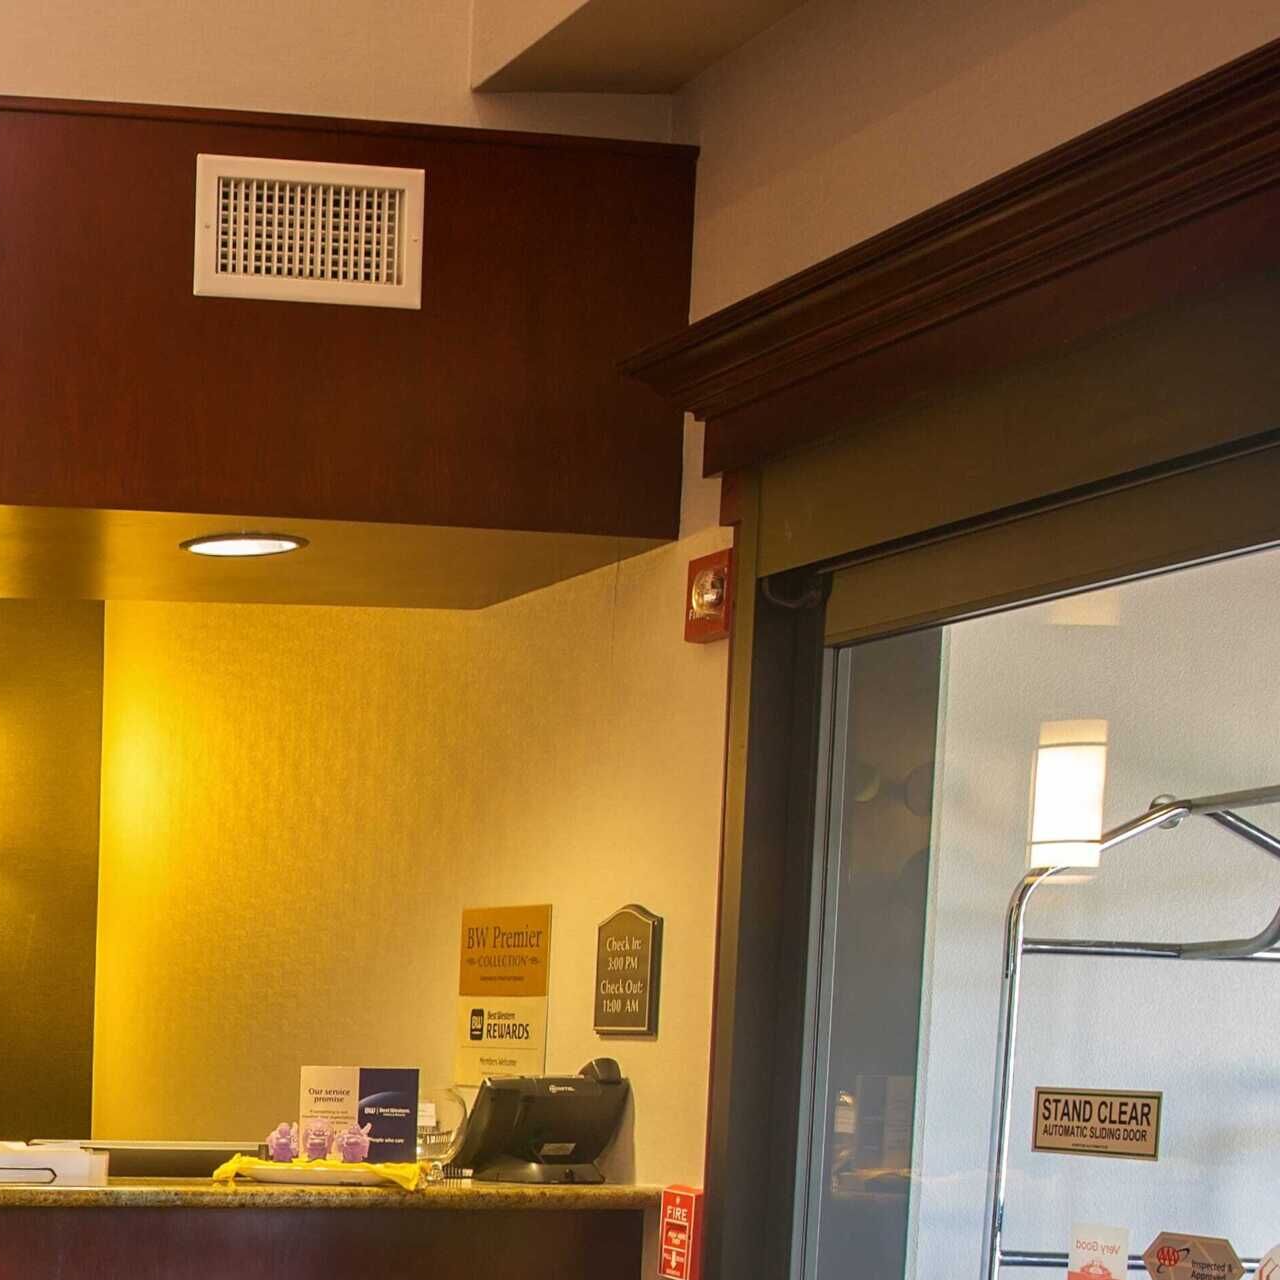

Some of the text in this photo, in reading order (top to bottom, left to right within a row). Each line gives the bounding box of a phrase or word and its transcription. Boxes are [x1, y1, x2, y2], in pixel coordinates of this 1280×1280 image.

[467, 924, 543, 949] BW Premier
[606, 936, 630, 952] Check
[478, 955, 528, 968] COLLECTION
[608, 956, 638, 971] 3:00 PM
[600, 979, 624, 995] Check
[603, 999, 639, 1013] 11:00 AM
[486, 1023, 530, 1040] REWARDS
[308, 1087, 351, 1096] Our service
[313, 1096, 345, 1105] promise
[1042, 1098, 1152, 1126] STAND CLEAR
[1042, 1123, 1148, 1142] AUTOMATIC SLIDING DOOR
[666, 1205, 688, 1221] FIRE
[1191, 1259, 1226, 1272] Inspected
